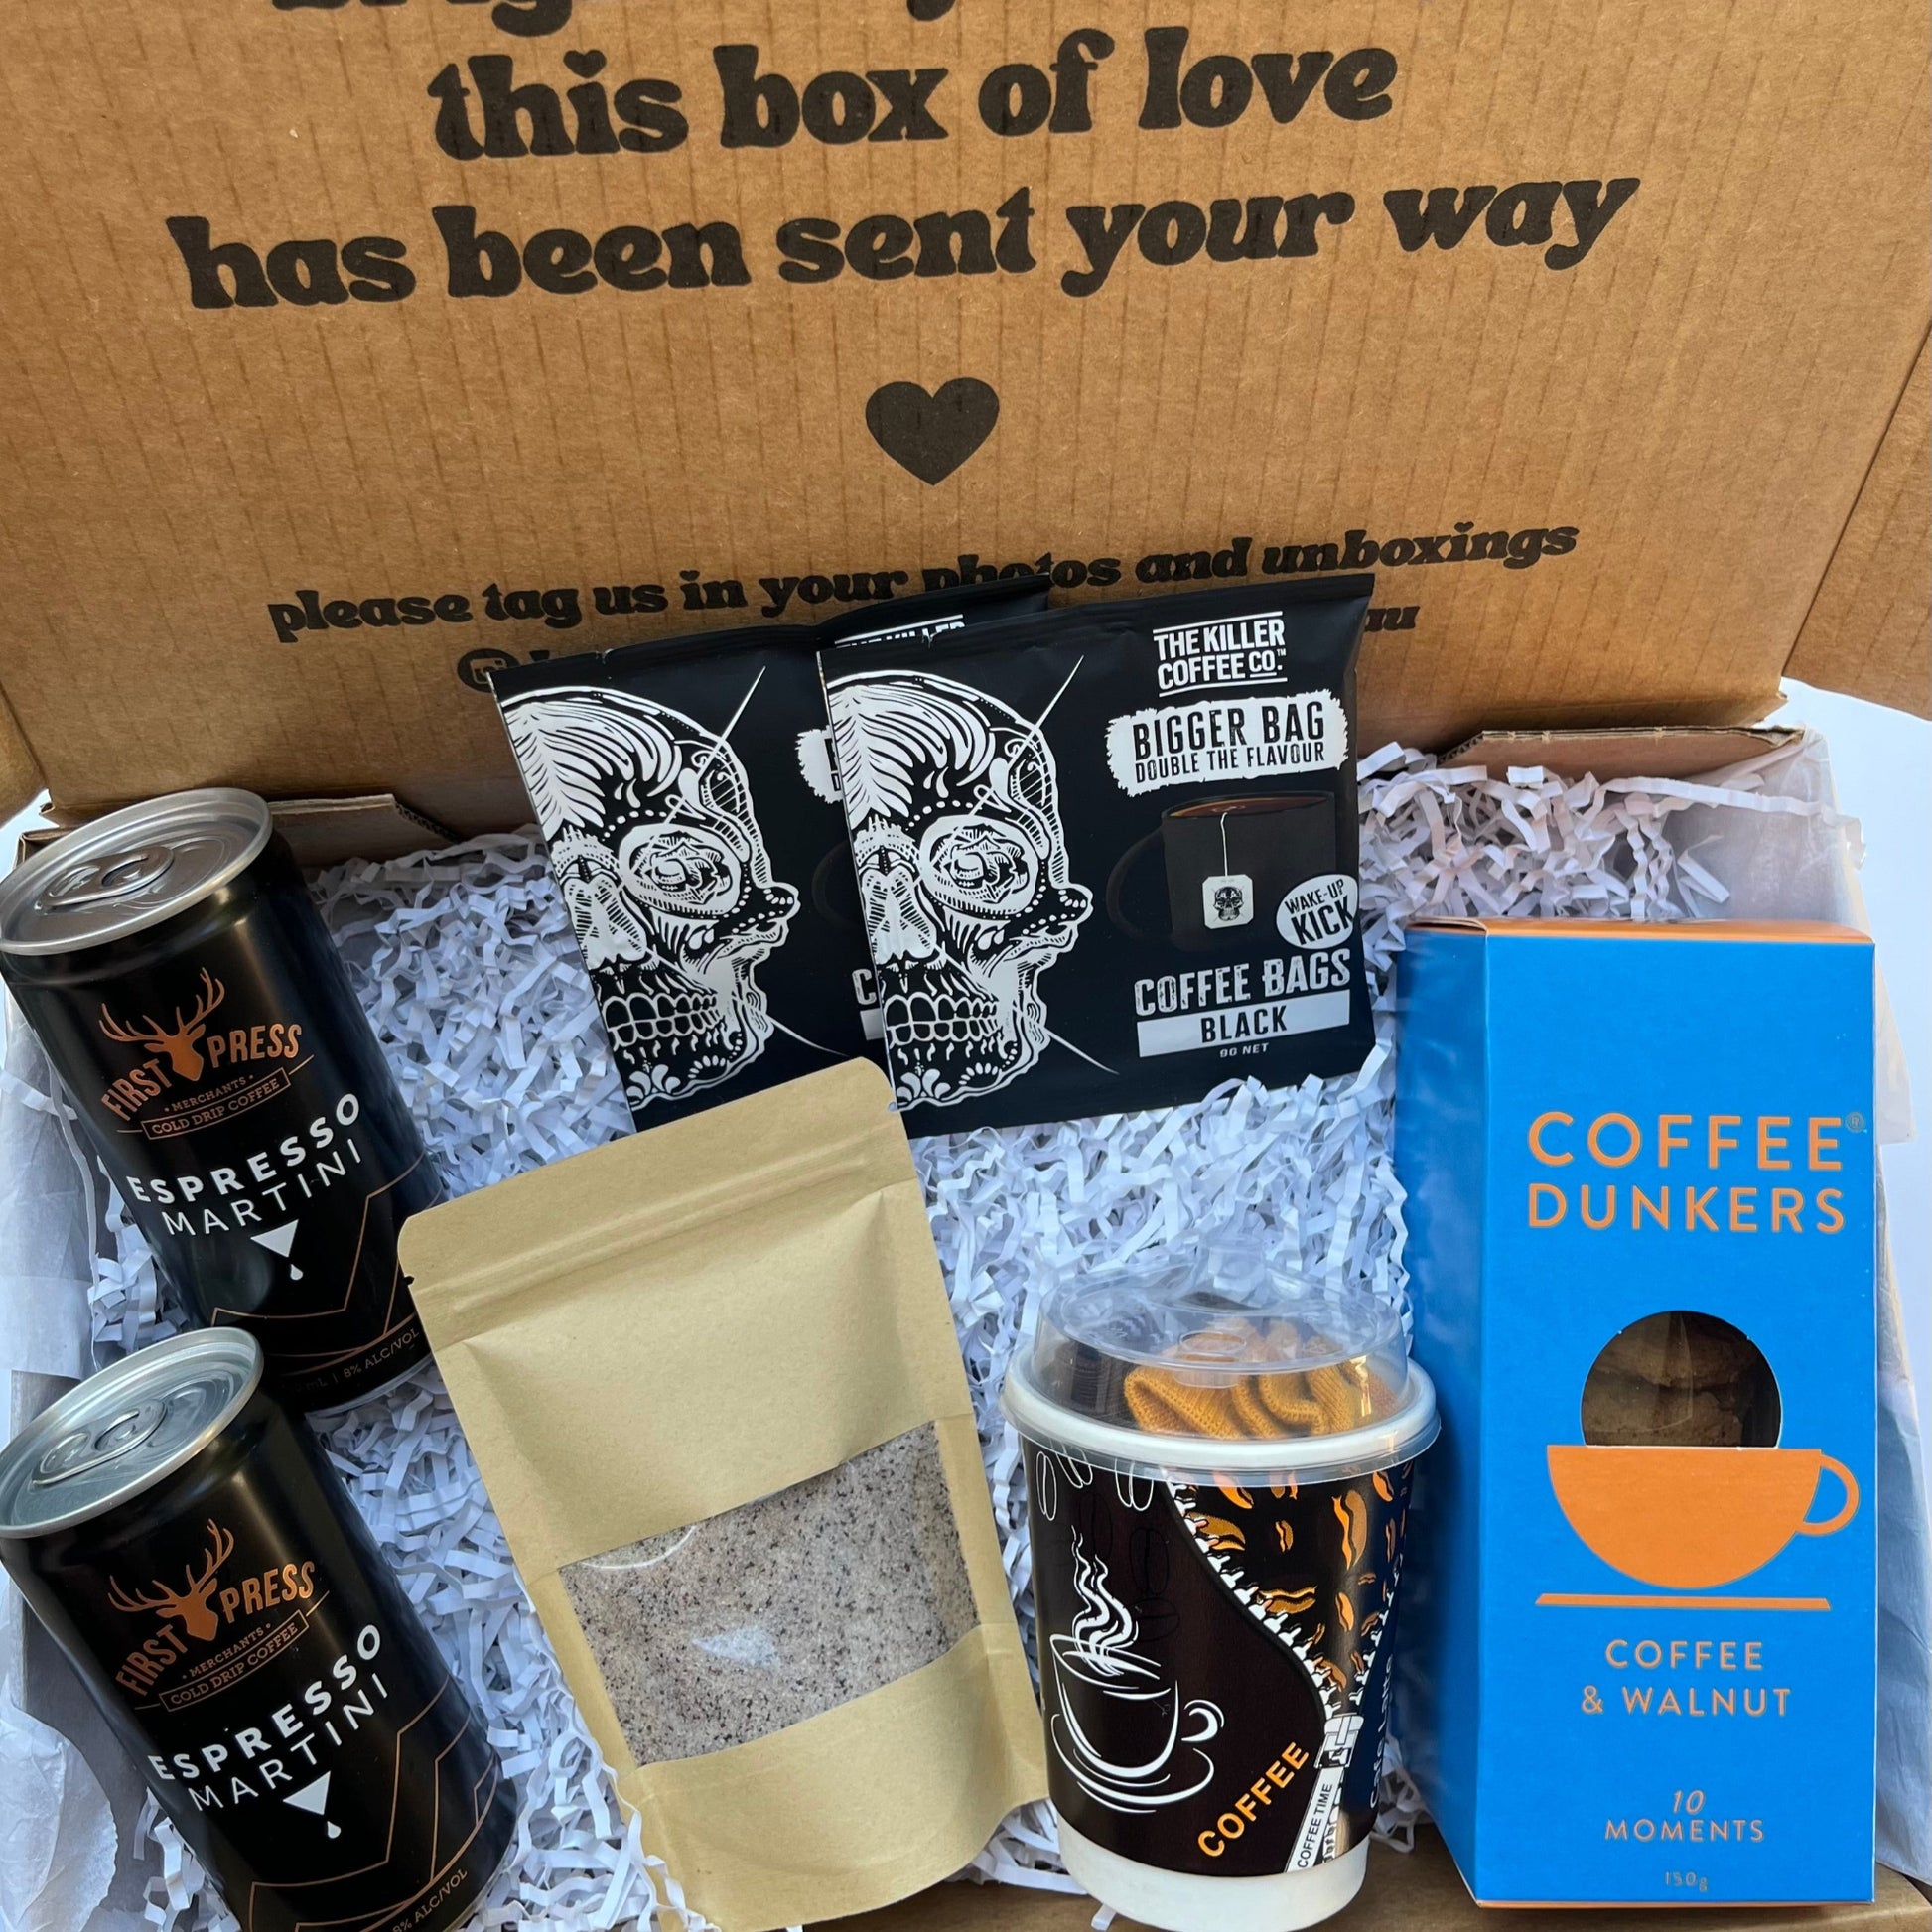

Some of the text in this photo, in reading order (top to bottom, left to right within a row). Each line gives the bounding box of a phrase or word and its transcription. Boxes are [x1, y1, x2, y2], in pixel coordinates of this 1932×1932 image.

[427, 26, 1398, 161] this box of love
[166, 177, 1641, 309] has been sent your way
[267, 590, 472, 643] please
[483, 582, 580, 629] tag
[594, 583, 666, 615] us
[678, 570, 748, 611] in
[759, 569, 909, 618] your
[1134, 537, 1250, 583] and
[1262, 521, 1581, 573] unboxings
[1154, 619, 1286, 661] THE KILLER
[1157, 653, 1246, 690] COFFEE
[1133, 701, 1325, 761] BIGGER BAG
[1136, 741, 1325, 783] DOUBLE THE FLAVOUR
[1284, 878, 1355, 946] WAKE-UP KICK
[1134, 948, 1351, 1016] COFFEE BAGS
[1200, 1005, 1288, 1043] BLACK
[1242, 1042, 1270, 1055] NET
[101, 1023, 302, 1121] FIRST PRESS
[171, 1076, 247, 1113] MERCHANTS
[152, 1078, 280, 1136] COLD DRIP COFFEE
[126, 1093, 359, 1204] ESPRESSO
[162, 1138, 361, 1236] MARTINI
[1529, 1183, 1845, 1234] DUNKERS
[364, 1328, 420, 1369] ALC/VOL
[115, 1560, 316, 1697] FIRST PRESS
[189, 1626, 265, 1678] MERCHANTS
[1605, 1639, 1763, 1670] COFFEE
[170, 1622, 299, 1706] COLD DRIP COFFEE
[148, 1624, 381, 1780] ESPRESSO
[1582, 1685, 1792, 1717] & WALNUT
[188, 1673, 388, 1812] MARTINI
[1197, 1741, 1310, 1858] COFFEE
[1297, 1783, 1333, 1868] COFFEE TIME
[1672, 1790, 1706, 1816] 10
[1604, 1819, 1765, 1843] MOMENTS
[414, 1868, 469, 1924] ALC/VOL
